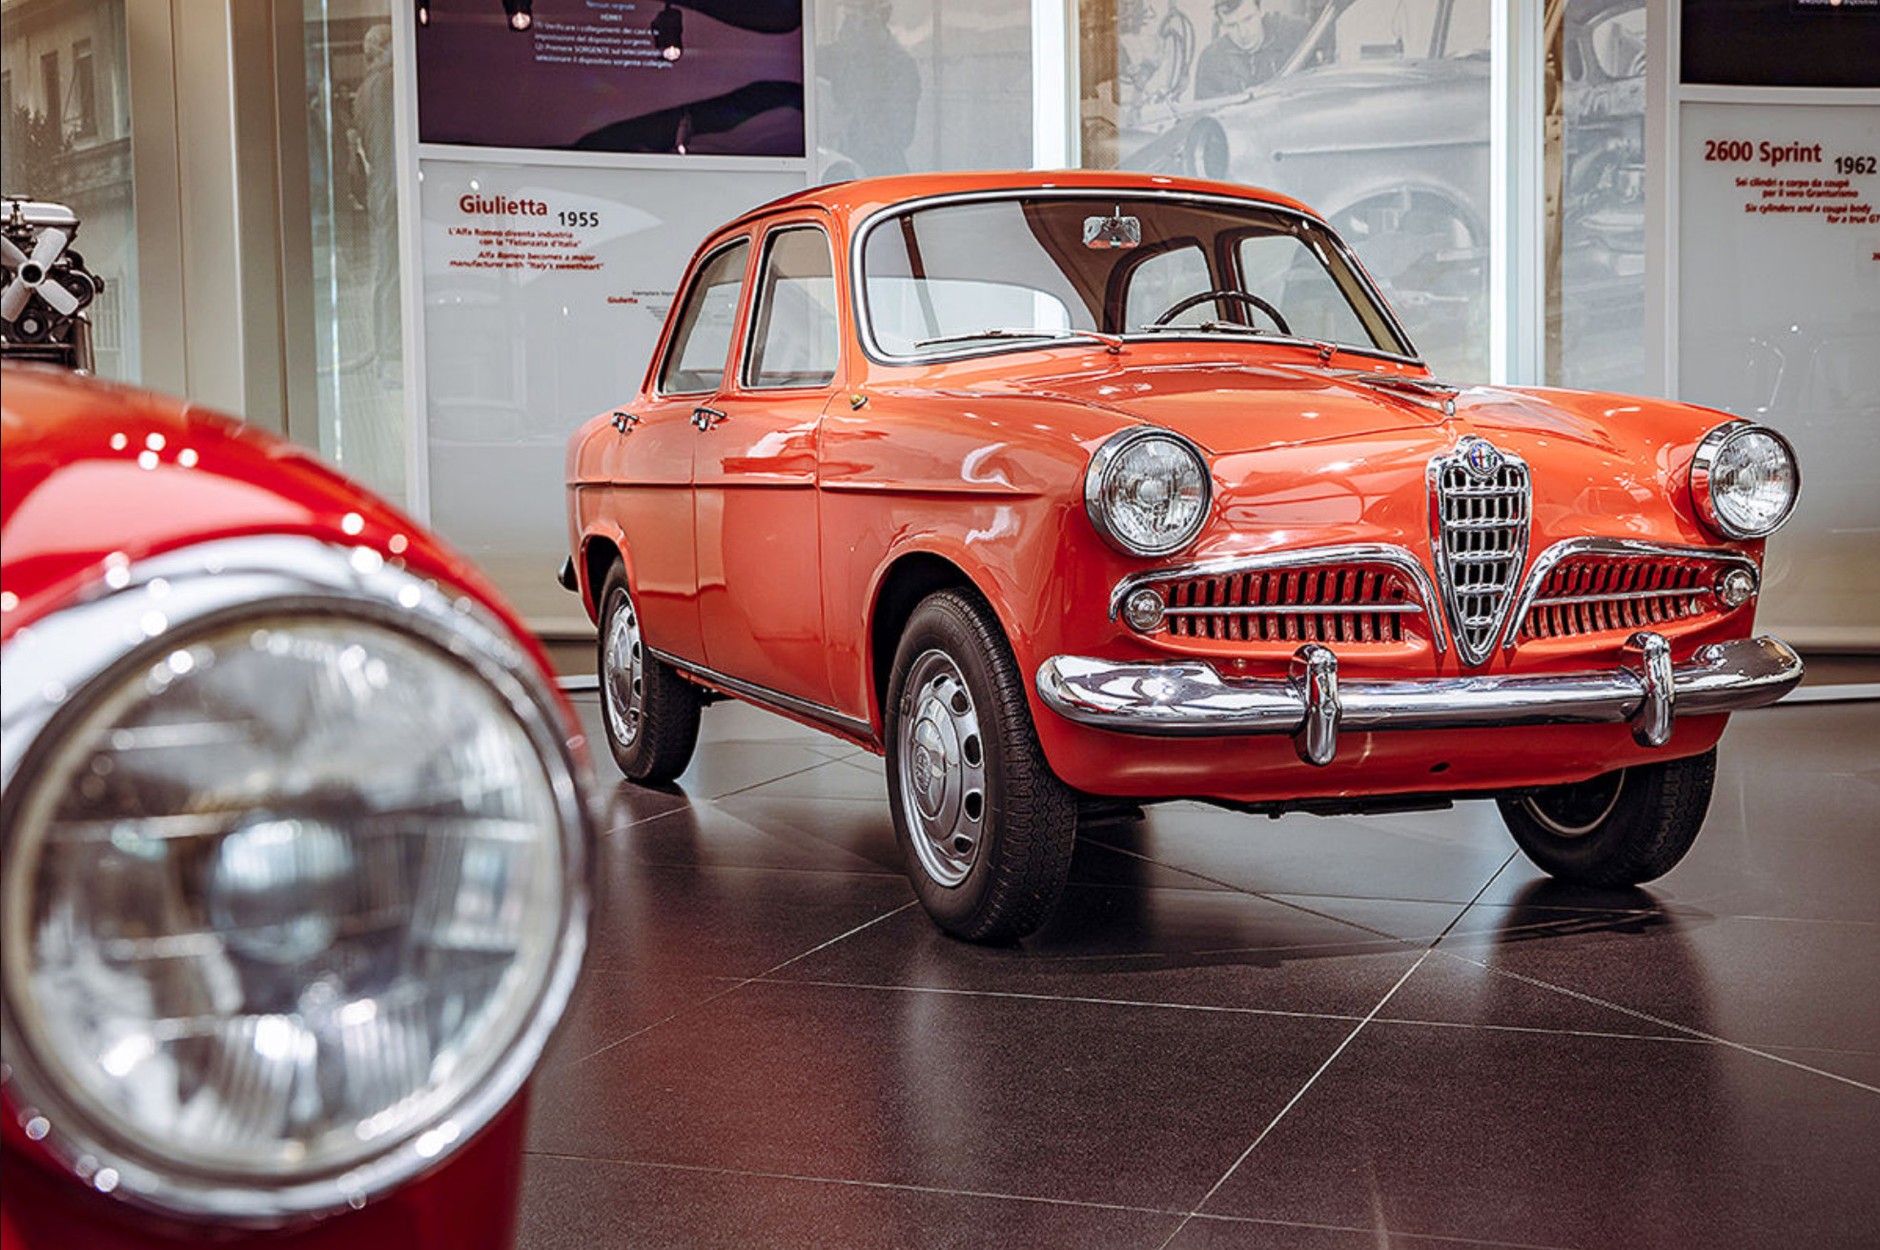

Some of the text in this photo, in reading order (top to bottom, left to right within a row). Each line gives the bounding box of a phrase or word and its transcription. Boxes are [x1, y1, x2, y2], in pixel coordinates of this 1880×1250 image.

[1704, 139, 1877, 175] 2600 Sprint 1962
[1750, 177, 1776, 187] cilindri
[1786, 180, 1809, 190] corpo
[1811, 178, 1822, 187] da
[1762, 190, 1776, 199] per
[1786, 190, 1804, 198] vero
[1806, 188, 1859, 198] Granturismo
[459, 194, 599, 227] Giulietta 1955
[1745, 203, 1757, 213] Six
[1759, 203, 1795, 215] cylinders
[1797, 204, 1814, 213] and
[1850, 203, 1872, 215] body
[1827, 214, 1841, 224] for
[1849, 215, 1867, 224] true
[475, 228, 503, 237] Romeo
[504, 228, 535, 238] diventa
[538, 230, 573, 239] industria
[478, 251, 494, 259] Alfa
[498, 252, 525, 260] Romeo
[528, 252, 562, 261] becomes
[572, 253, 596, 263] major
[449, 260, 503, 269] manufacturer
[505, 261, 524, 269] with
[607, 296, 638, 304] Giulietta
